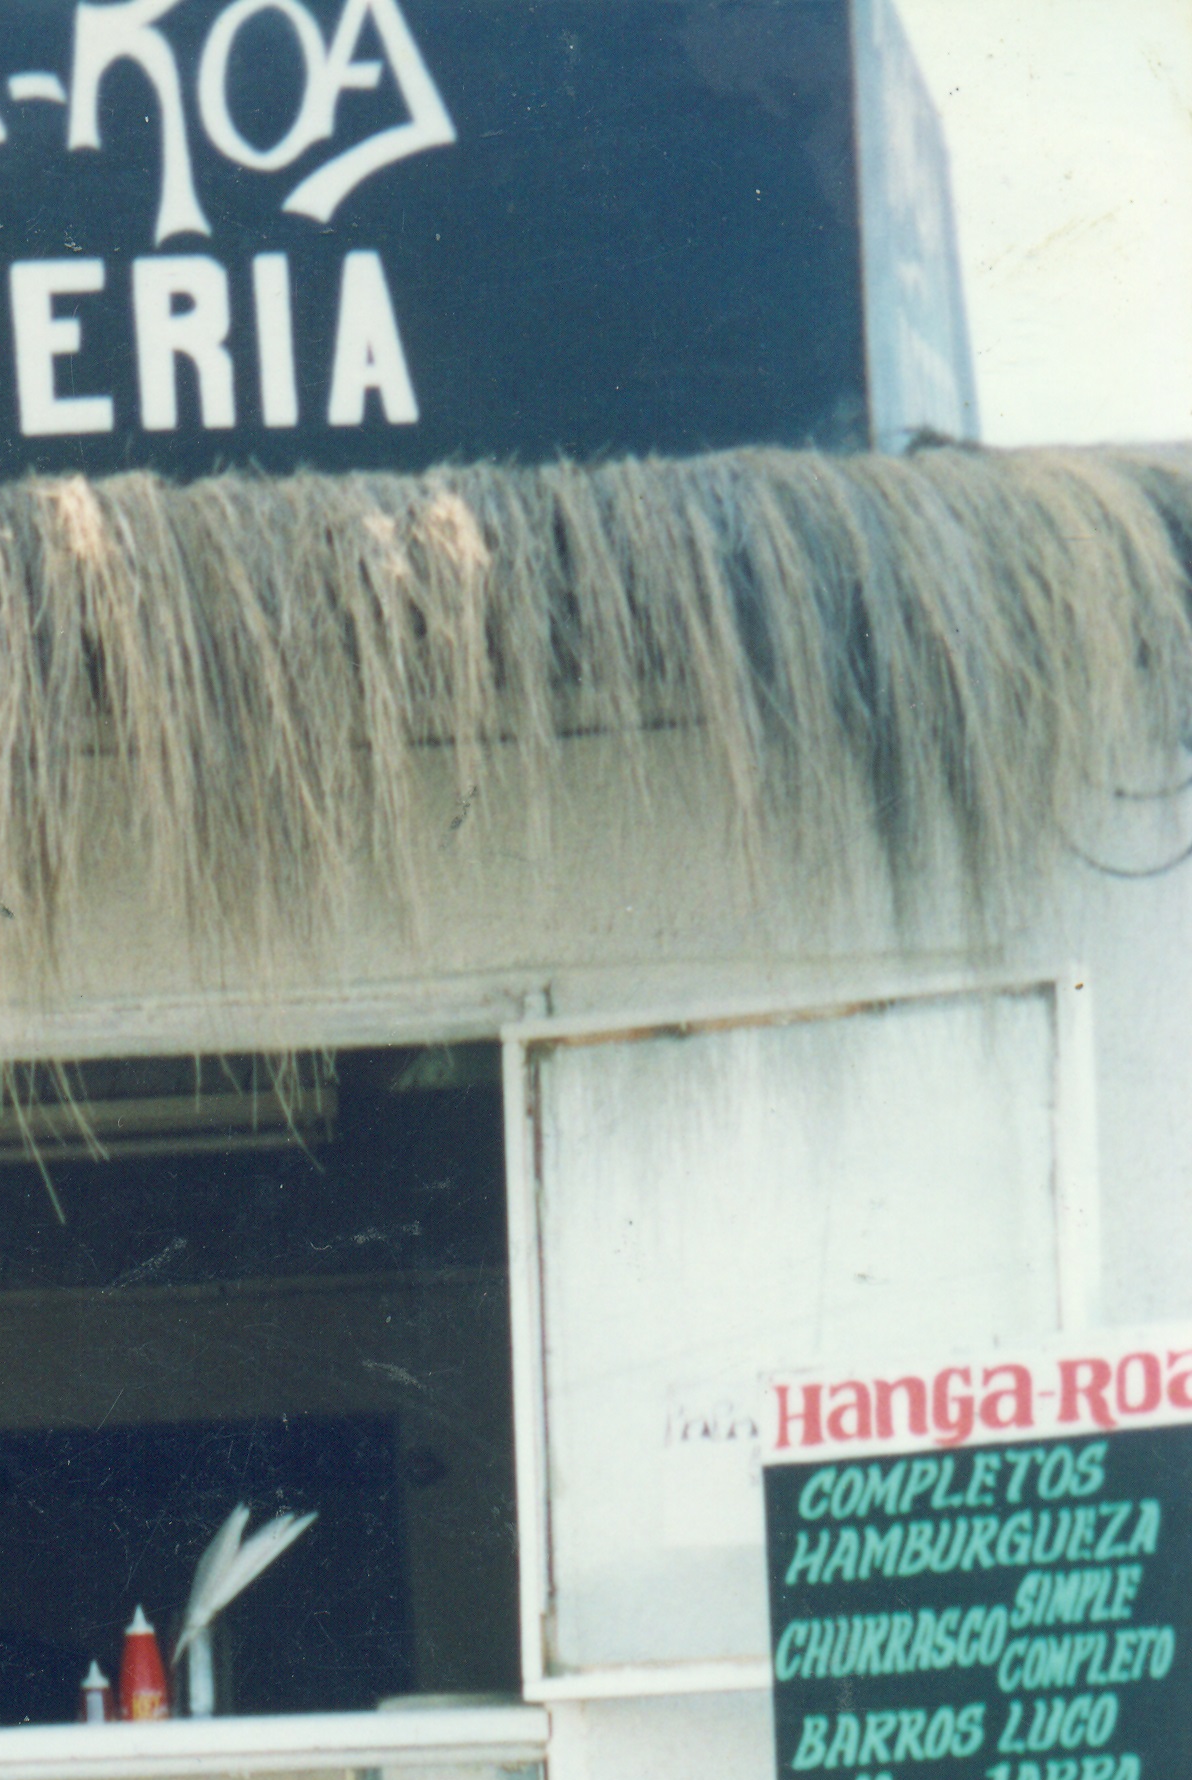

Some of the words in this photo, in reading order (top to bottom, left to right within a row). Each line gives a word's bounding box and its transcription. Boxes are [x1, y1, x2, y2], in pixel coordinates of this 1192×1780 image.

[798, 1442, 1106, 1519] COMPLETOS
[786, 1499, 1162, 1585] HAMBURGUEZA
[1011, 1565, 1142, 1629] SIMPLE
[775, 1605, 1008, 1681] CHURRASCO
[998, 1626, 1175, 1692] COMPLETO
[792, 1704, 985, 1770] BARROS
[999, 1694, 1118, 1753] LUCO
